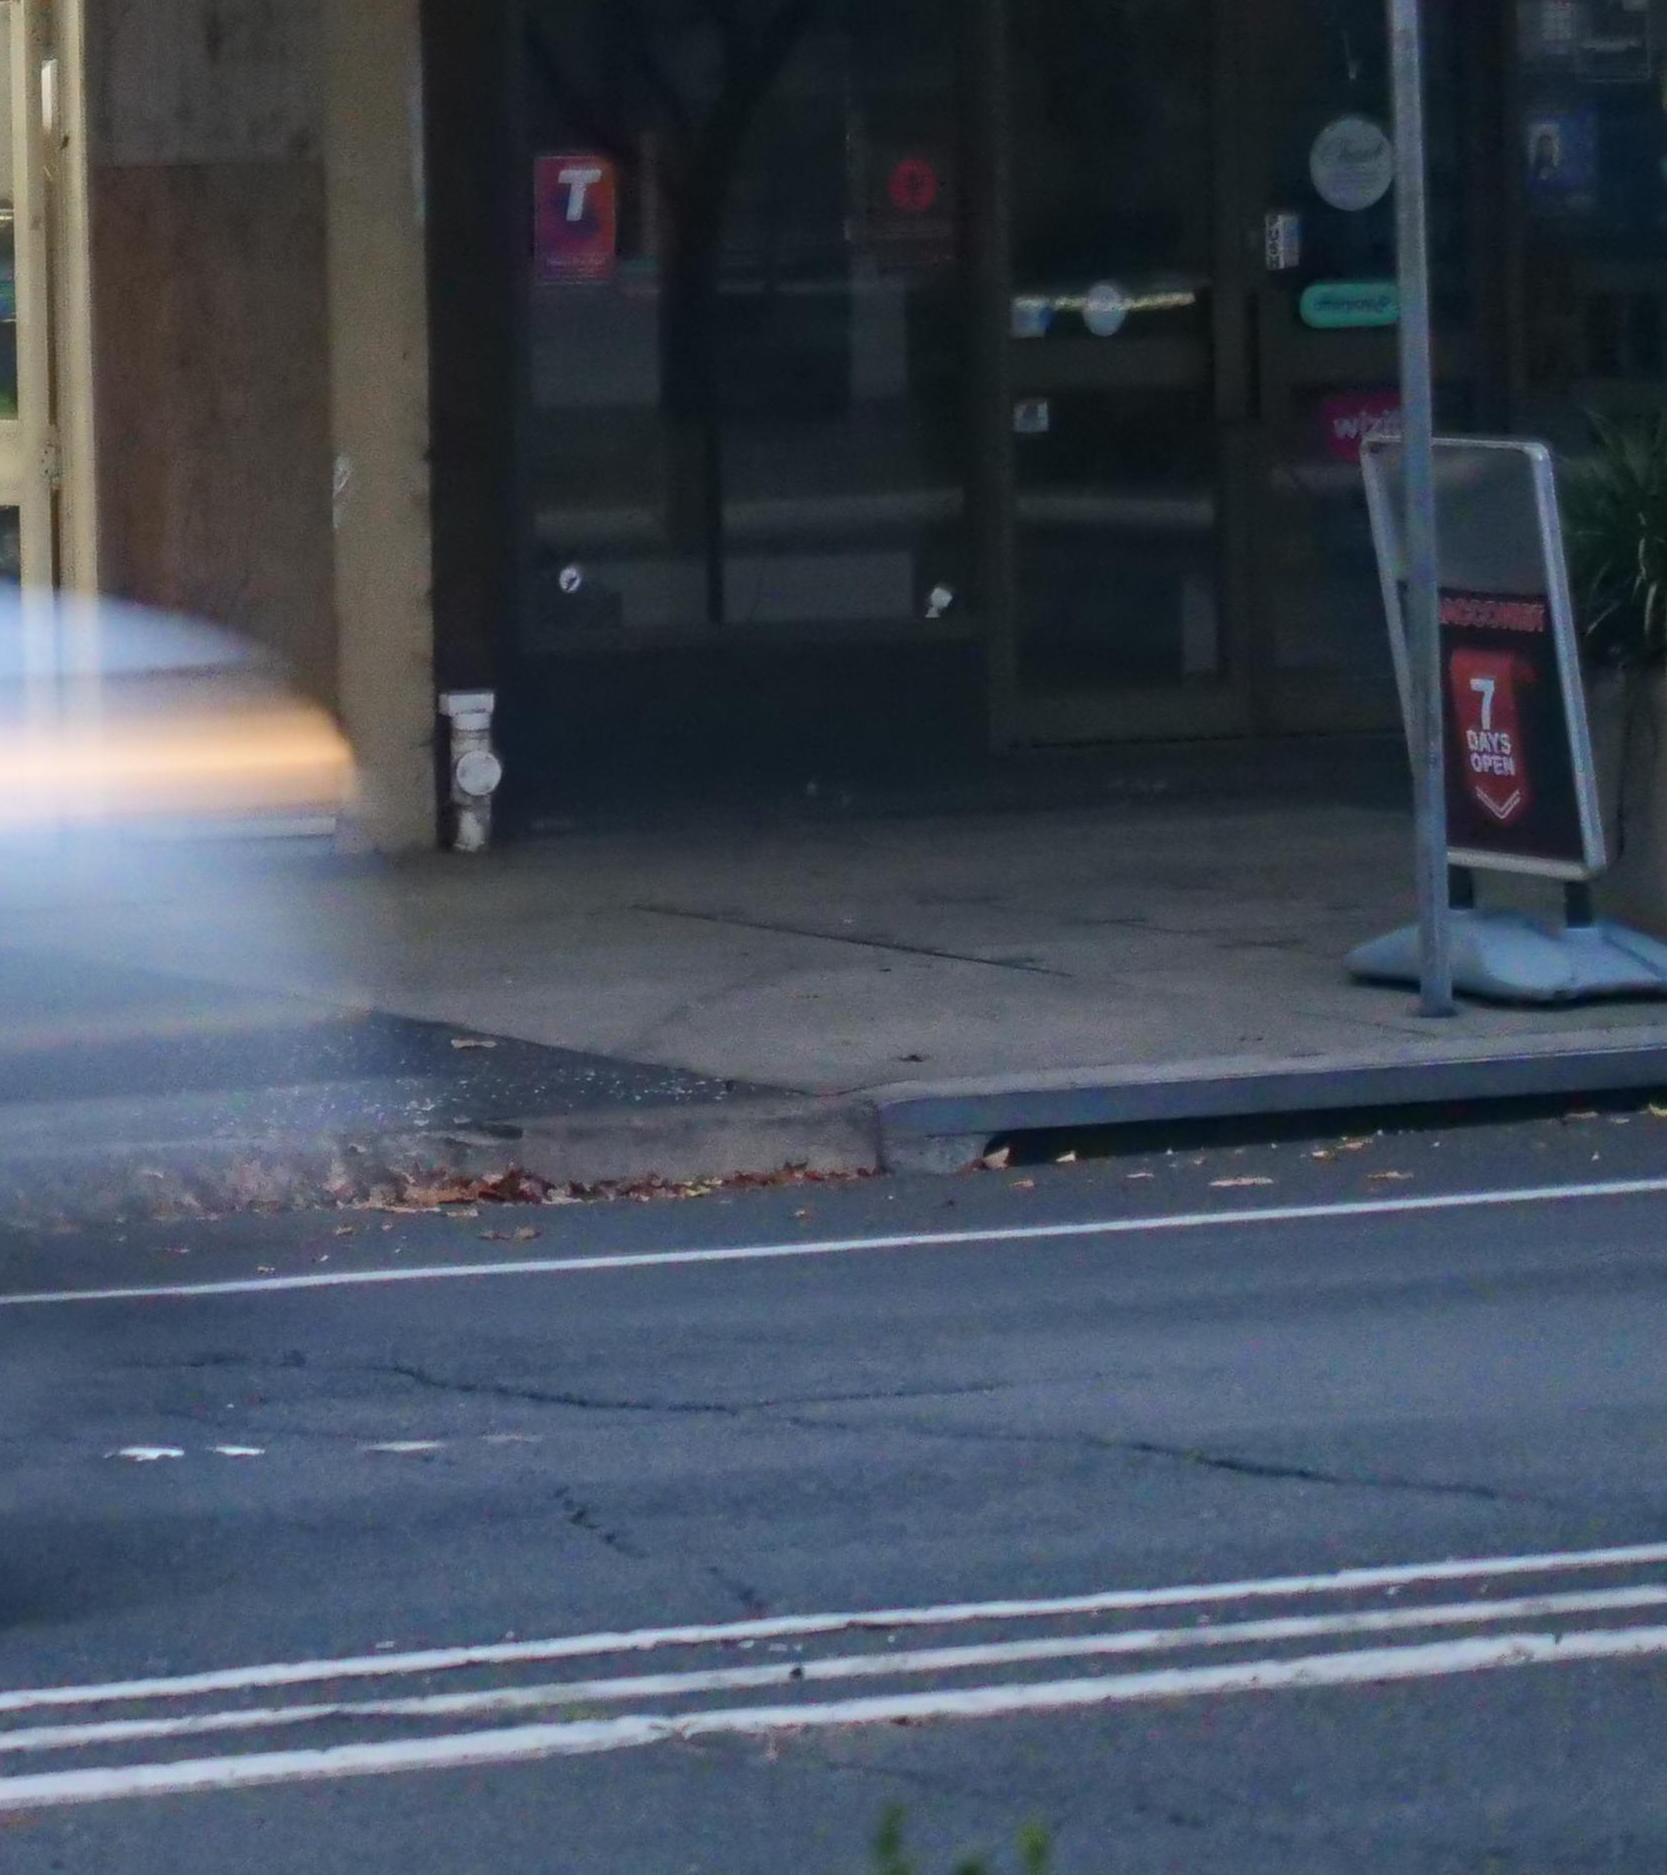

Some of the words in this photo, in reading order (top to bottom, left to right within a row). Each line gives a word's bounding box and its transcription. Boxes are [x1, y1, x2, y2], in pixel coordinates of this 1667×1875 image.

[1470, 678, 1495, 729] 7
[1466, 729, 1512, 754] DAYS
[1470, 753, 1516, 777] OPEN
